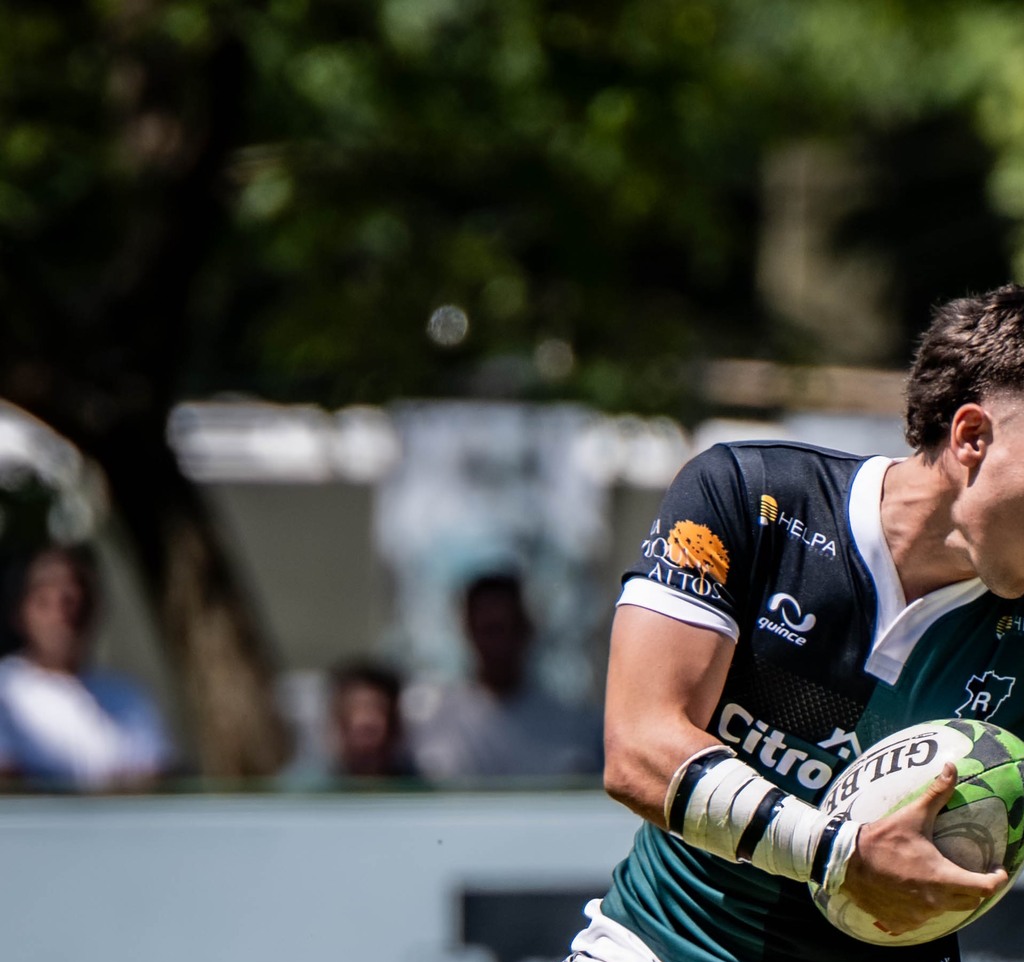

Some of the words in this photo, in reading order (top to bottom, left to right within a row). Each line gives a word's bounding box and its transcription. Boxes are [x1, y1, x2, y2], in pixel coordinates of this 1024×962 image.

[777, 511, 837, 556] HELPA
[758, 616, 807, 646] quince
[971, 691, 991, 712] R
